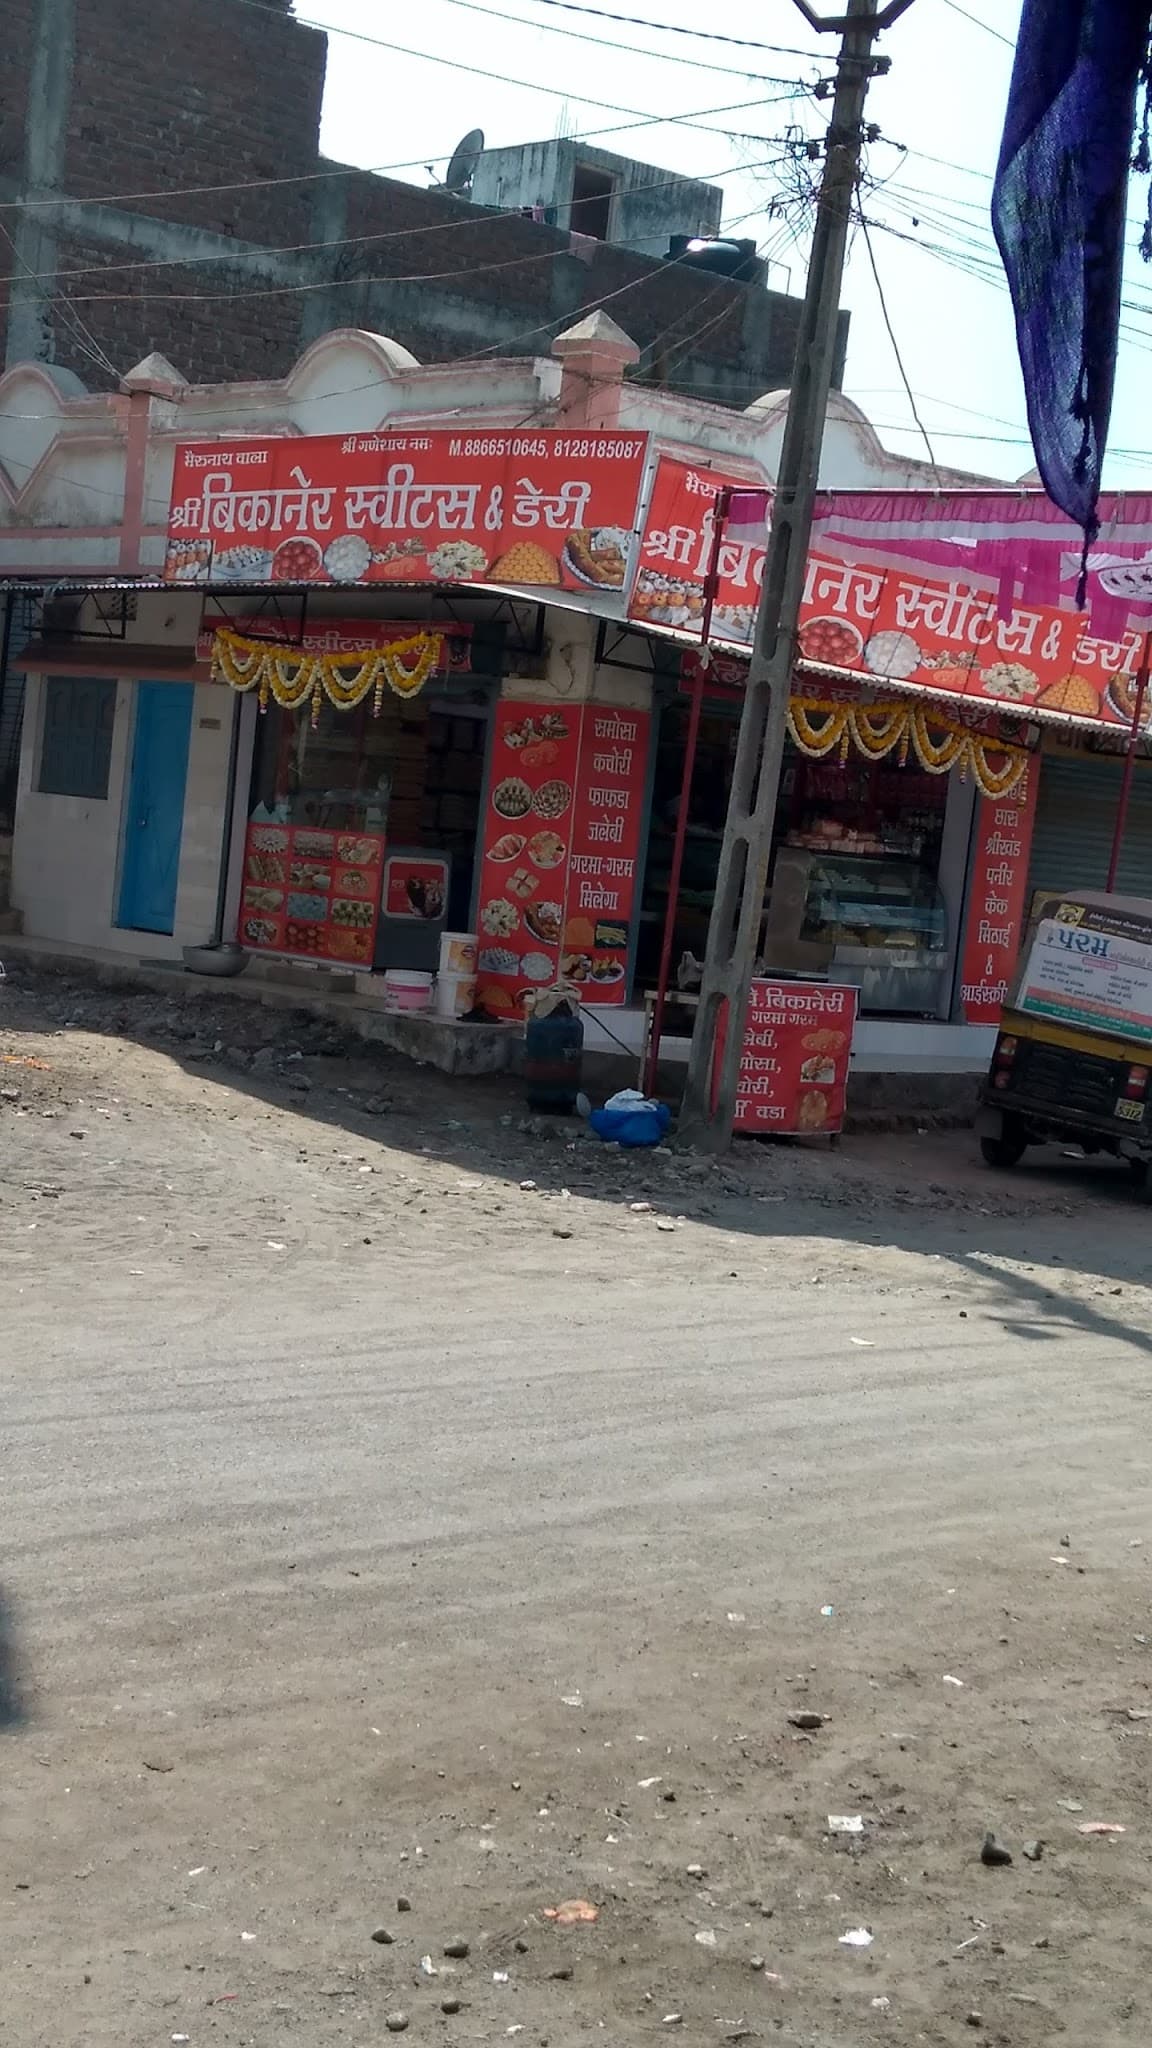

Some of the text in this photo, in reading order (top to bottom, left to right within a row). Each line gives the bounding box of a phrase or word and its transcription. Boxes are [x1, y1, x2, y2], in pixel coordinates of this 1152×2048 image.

[341, 435, 432, 454] श्री गणेशाय नमः
[449, 438, 643, 459] M.8866510645, 8128185087
[236, 451, 269, 464] वाला
[169, 463, 592, 533] श्री बिकानेर स्वीटस & डेरी
[643, 524, 697, 567] श्री
[1041, 619, 1062, 660] &
[594, 712, 637, 741] समोसा
[593, 746, 632, 775] कचोरी
[588, 786, 630, 809] फाफडा
[588, 814, 625, 842] जलेबी
[985, 831, 1022, 856] श्रीखंड
[571, 854, 634, 877] गरमा-गरम
[986, 862, 1014, 886] पनीर
[579, 881, 619, 910] मिलेगा
[985, 890, 1009, 915] केक
[977, 920, 1014, 948] मिठाई
[960, 978, 1008, 1005] आईस्क्री
[752, 1010, 786, 1024] गरमा
[755, 1105, 787, 1120] वडा
